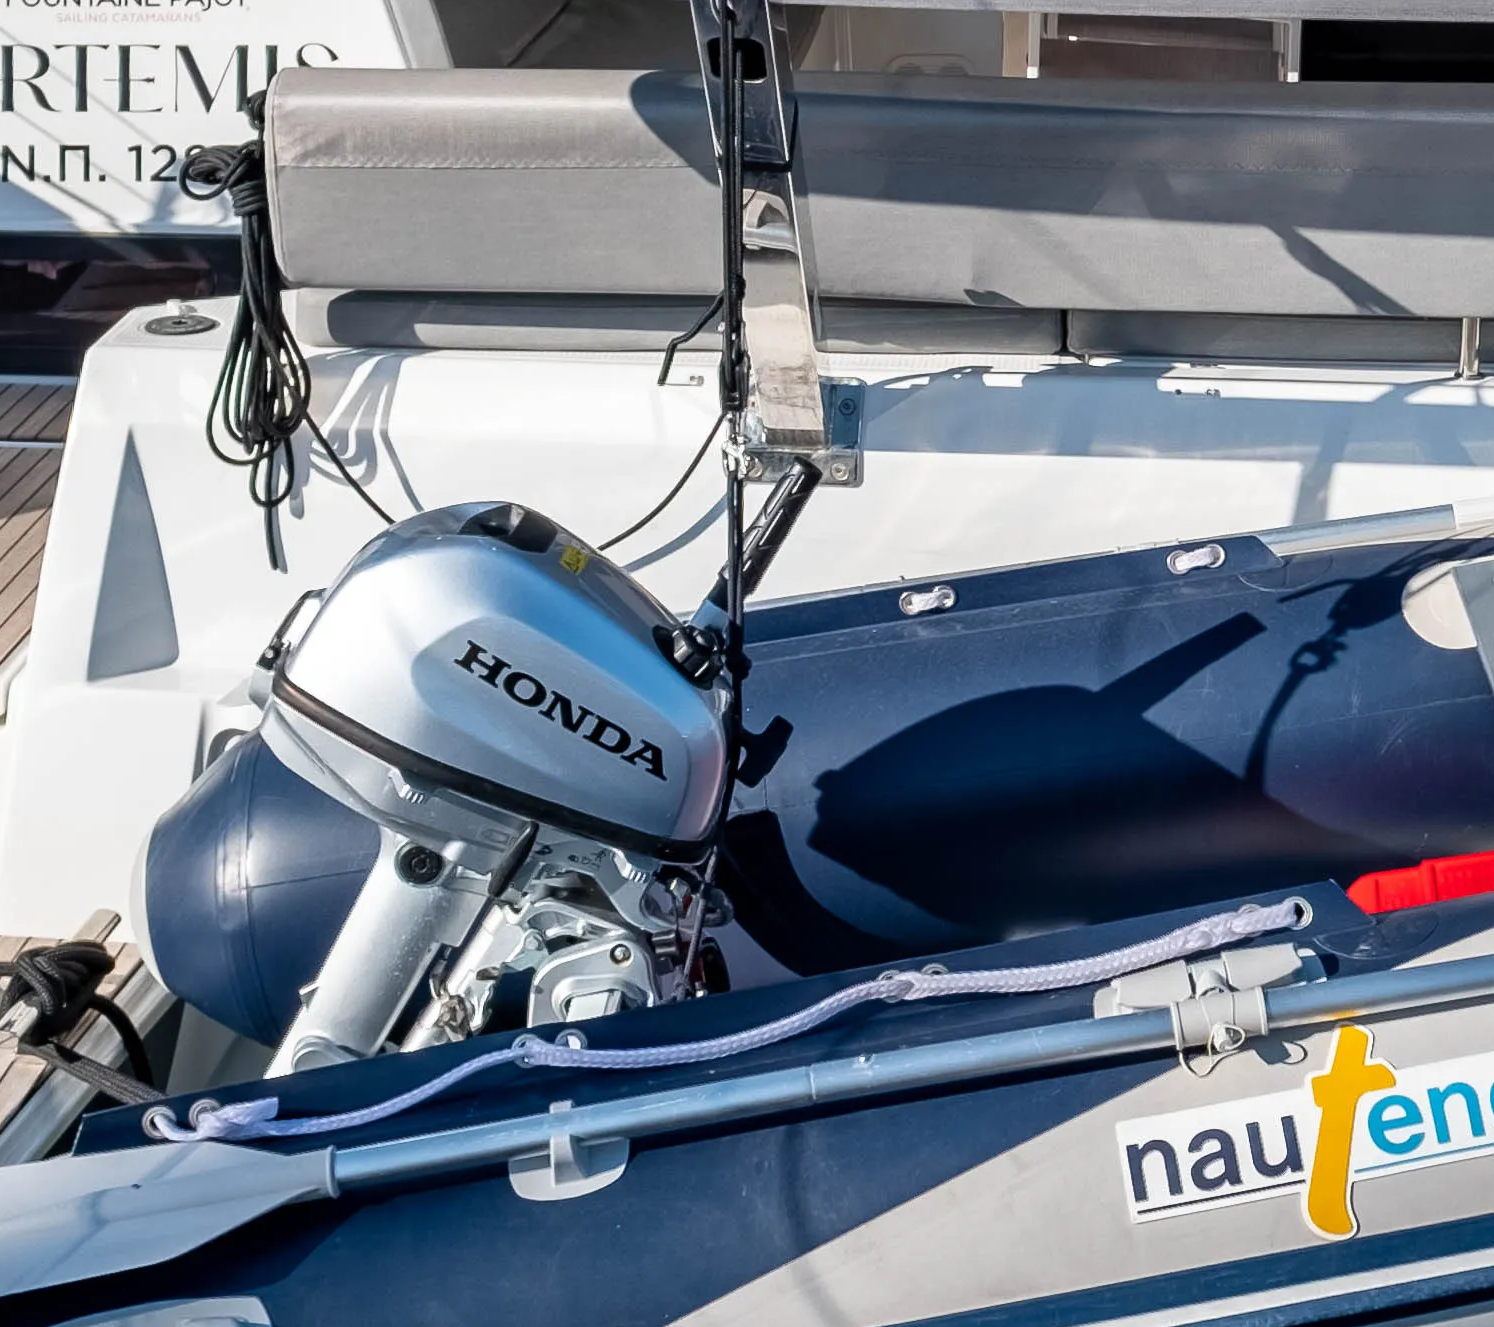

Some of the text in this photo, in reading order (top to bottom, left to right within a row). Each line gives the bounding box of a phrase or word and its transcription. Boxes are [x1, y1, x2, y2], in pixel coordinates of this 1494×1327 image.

[55, 12, 203, 23] SAILING CATAMARANS
[453, 639, 669, 781] HONDA
